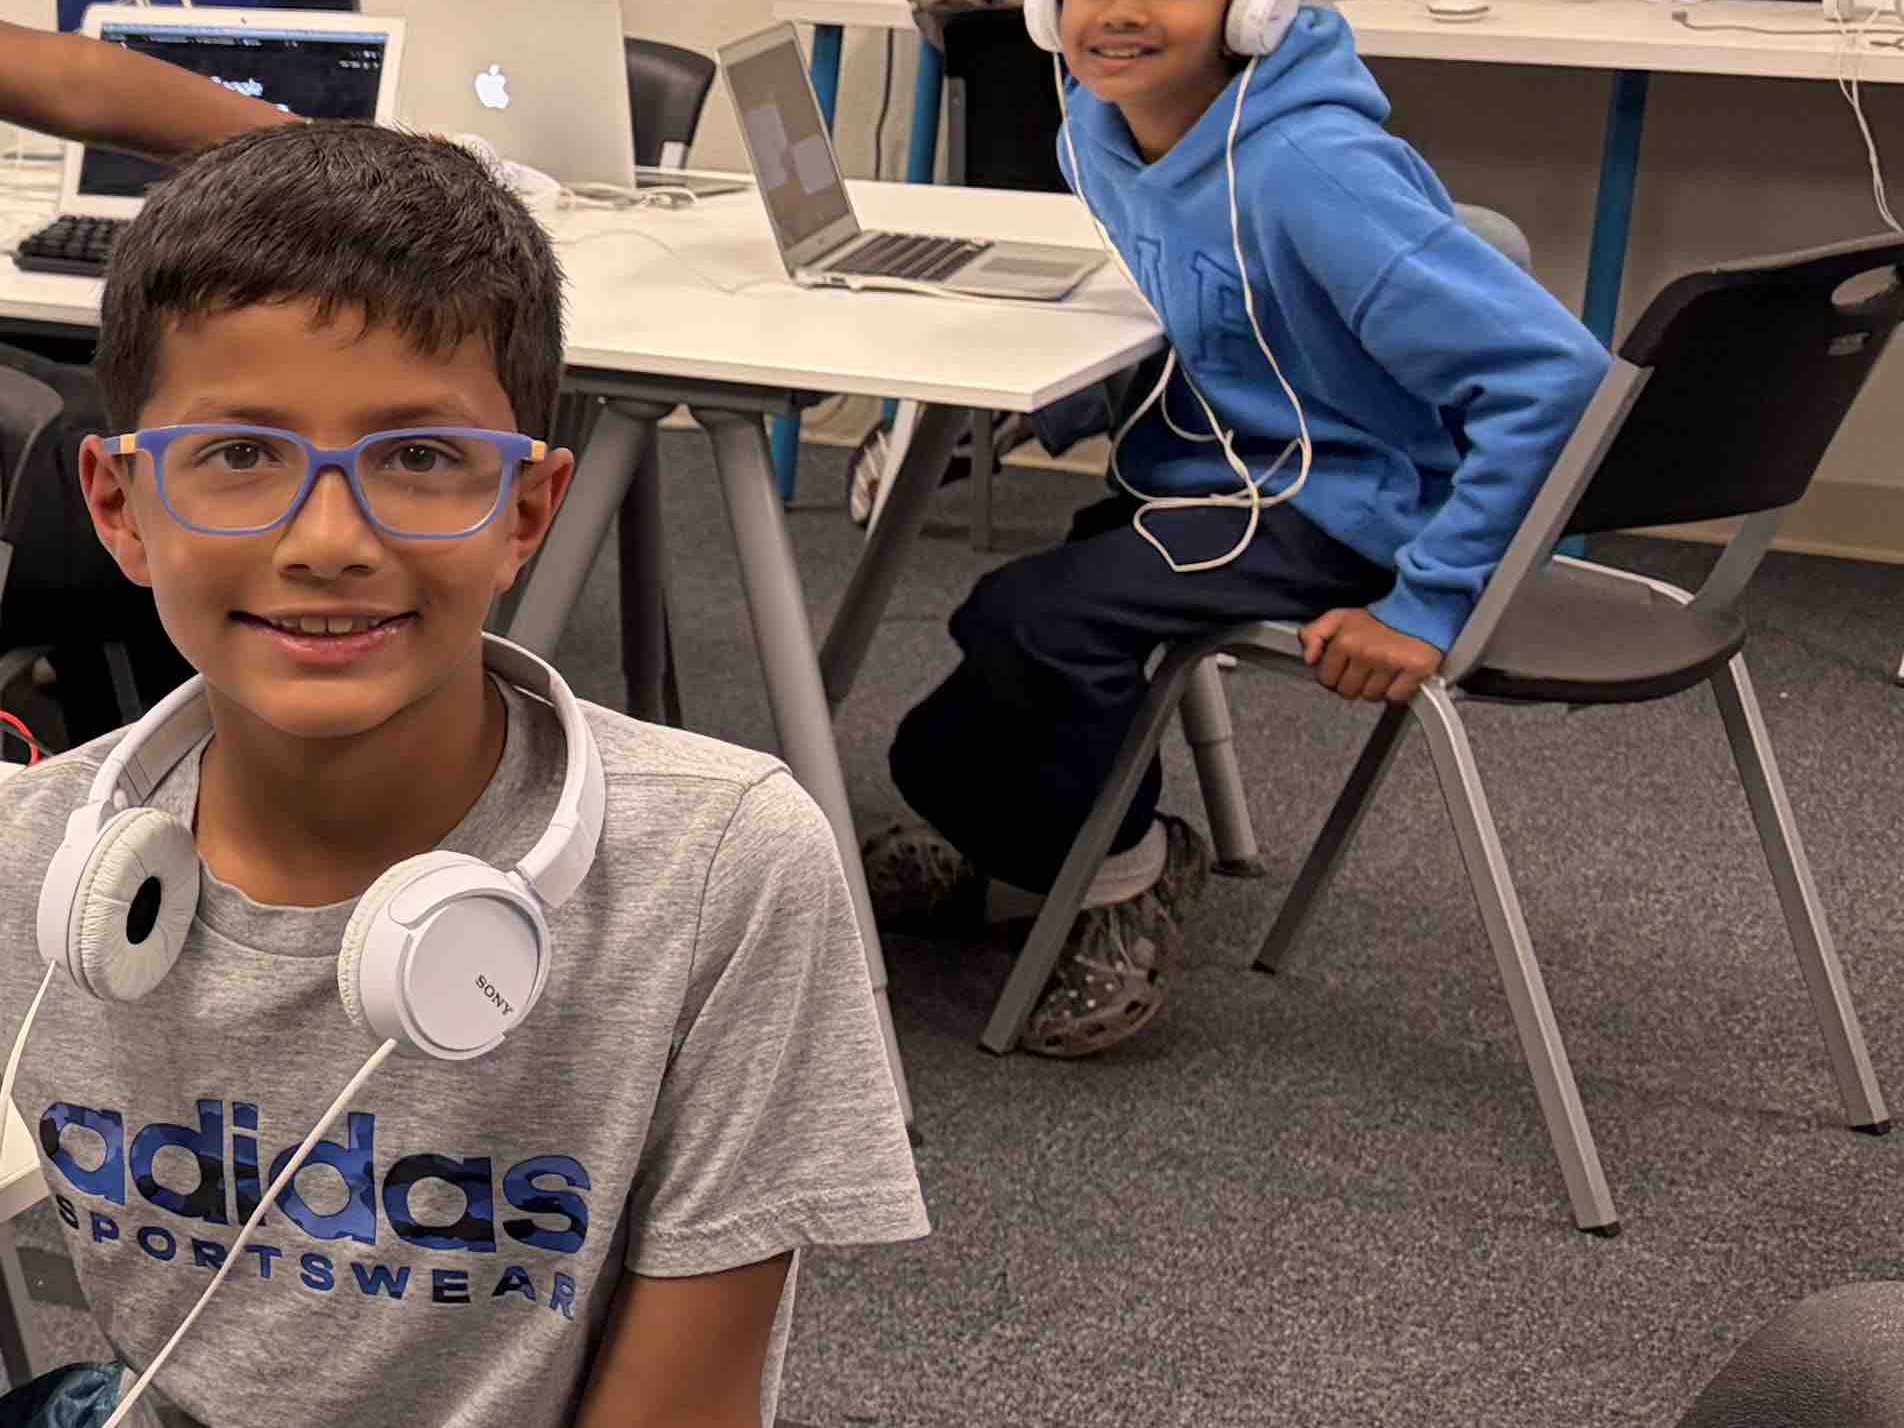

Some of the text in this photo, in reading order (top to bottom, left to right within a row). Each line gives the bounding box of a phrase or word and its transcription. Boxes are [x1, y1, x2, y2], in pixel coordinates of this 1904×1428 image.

[474, 973, 513, 1016] SONY
[38, 1098, 592, 1254] adidas
[55, 1192, 578, 1322] SPORTSWEAR
